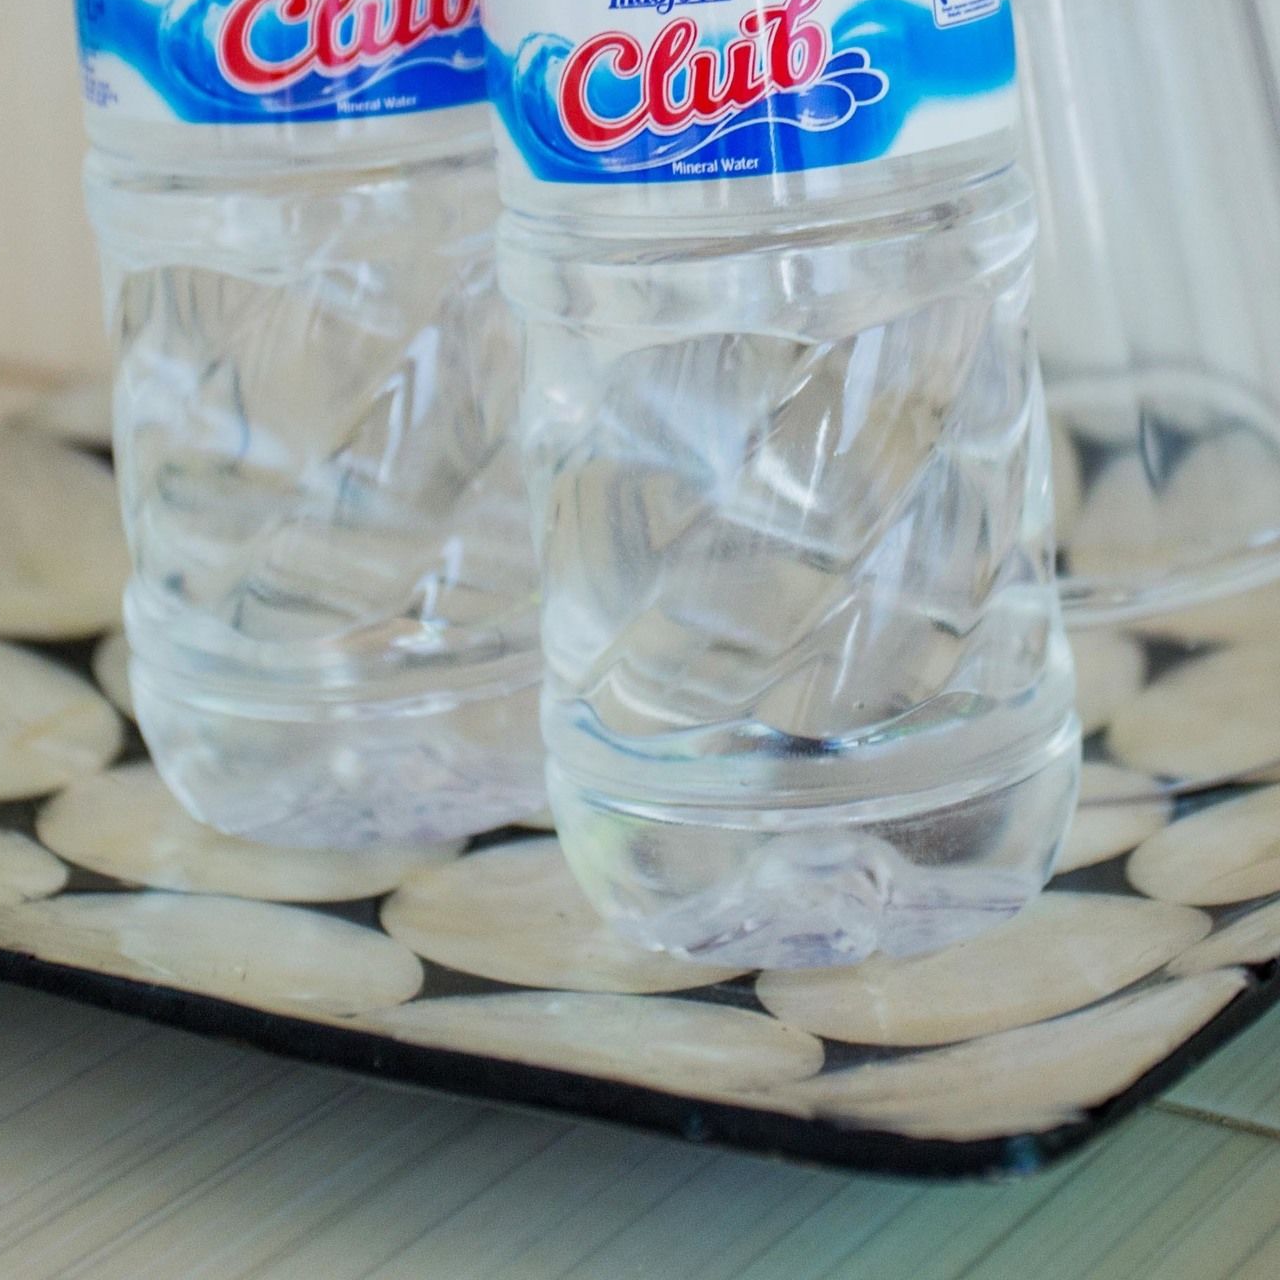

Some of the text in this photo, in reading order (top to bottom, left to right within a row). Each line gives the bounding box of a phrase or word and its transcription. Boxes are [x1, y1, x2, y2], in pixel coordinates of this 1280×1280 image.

[336, 95, 417, 113] Mineral Water
[671, 156, 760, 175] Mineral Water
